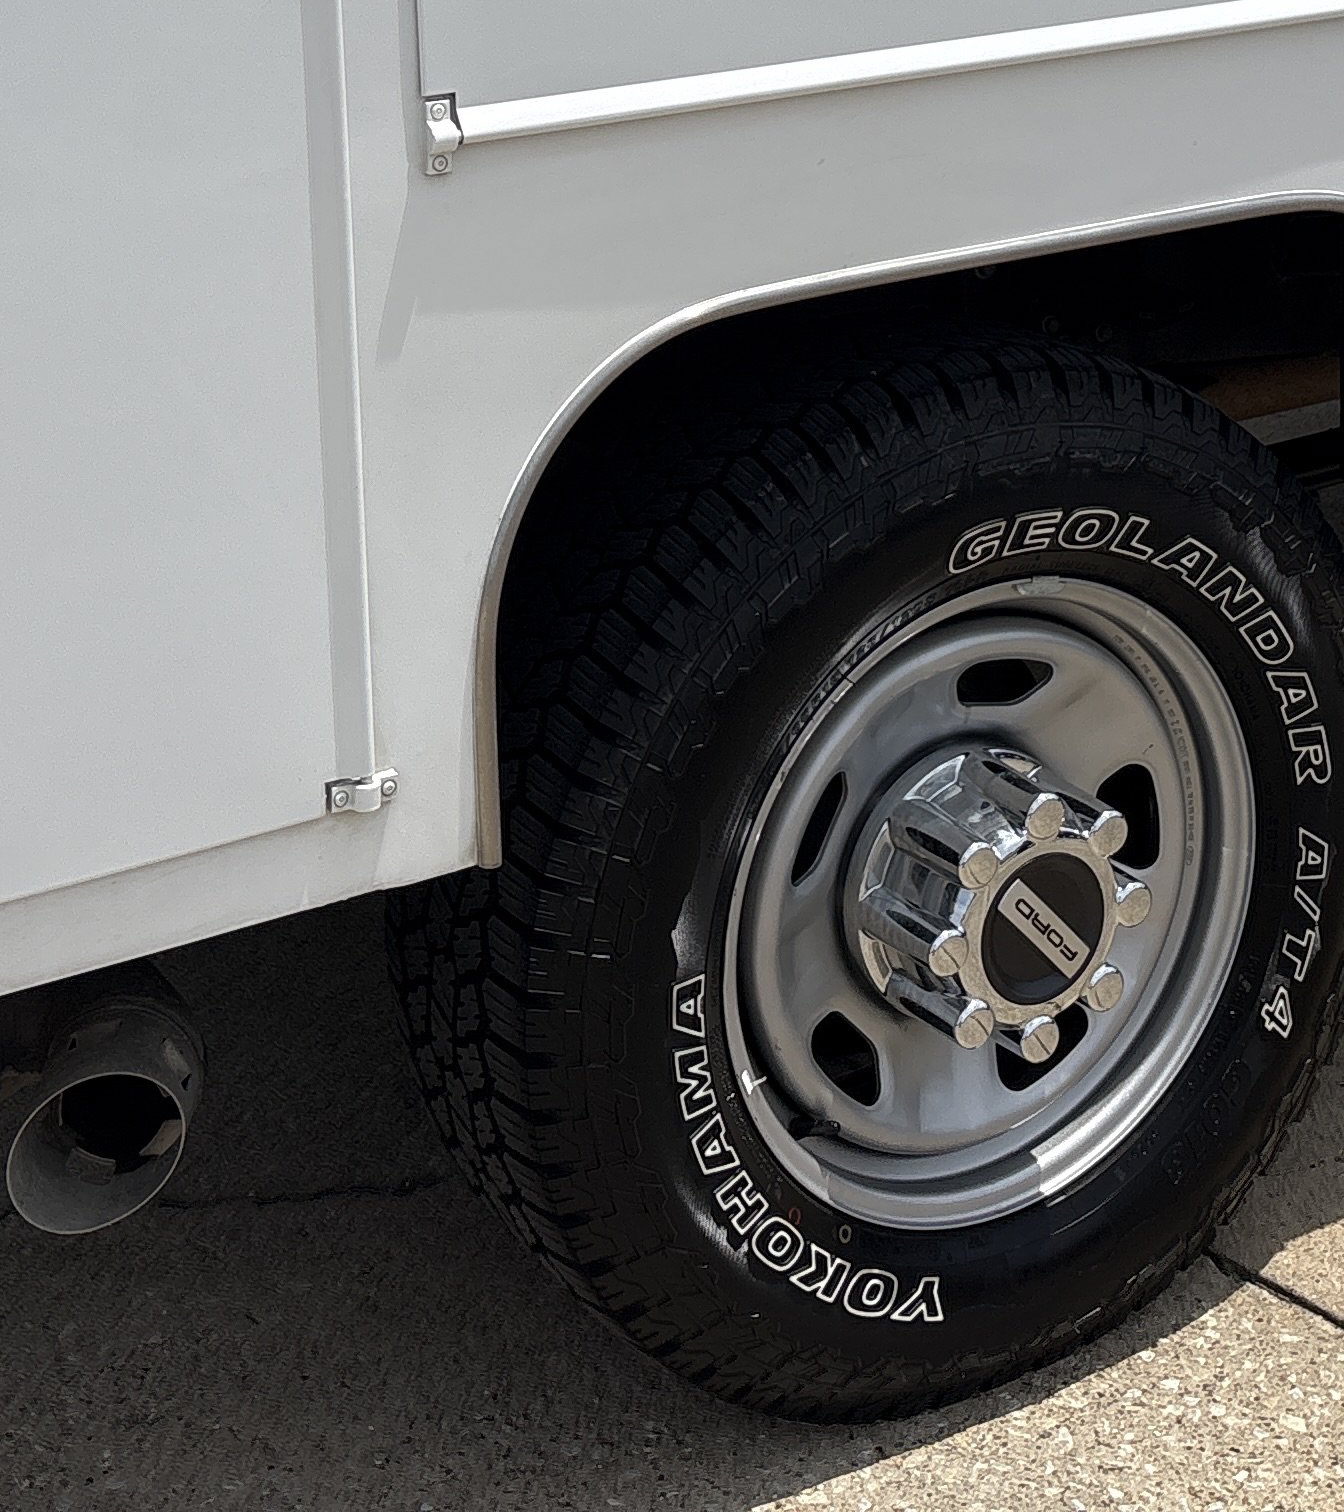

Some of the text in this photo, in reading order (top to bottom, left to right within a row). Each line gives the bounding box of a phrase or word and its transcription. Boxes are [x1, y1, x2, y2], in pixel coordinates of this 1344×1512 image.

[947, 506, 1333, 786] GEOLANDAR
[1014, 896, 1079, 963] FORD
[672, 973, 945, 1323] YOKOHAMA
